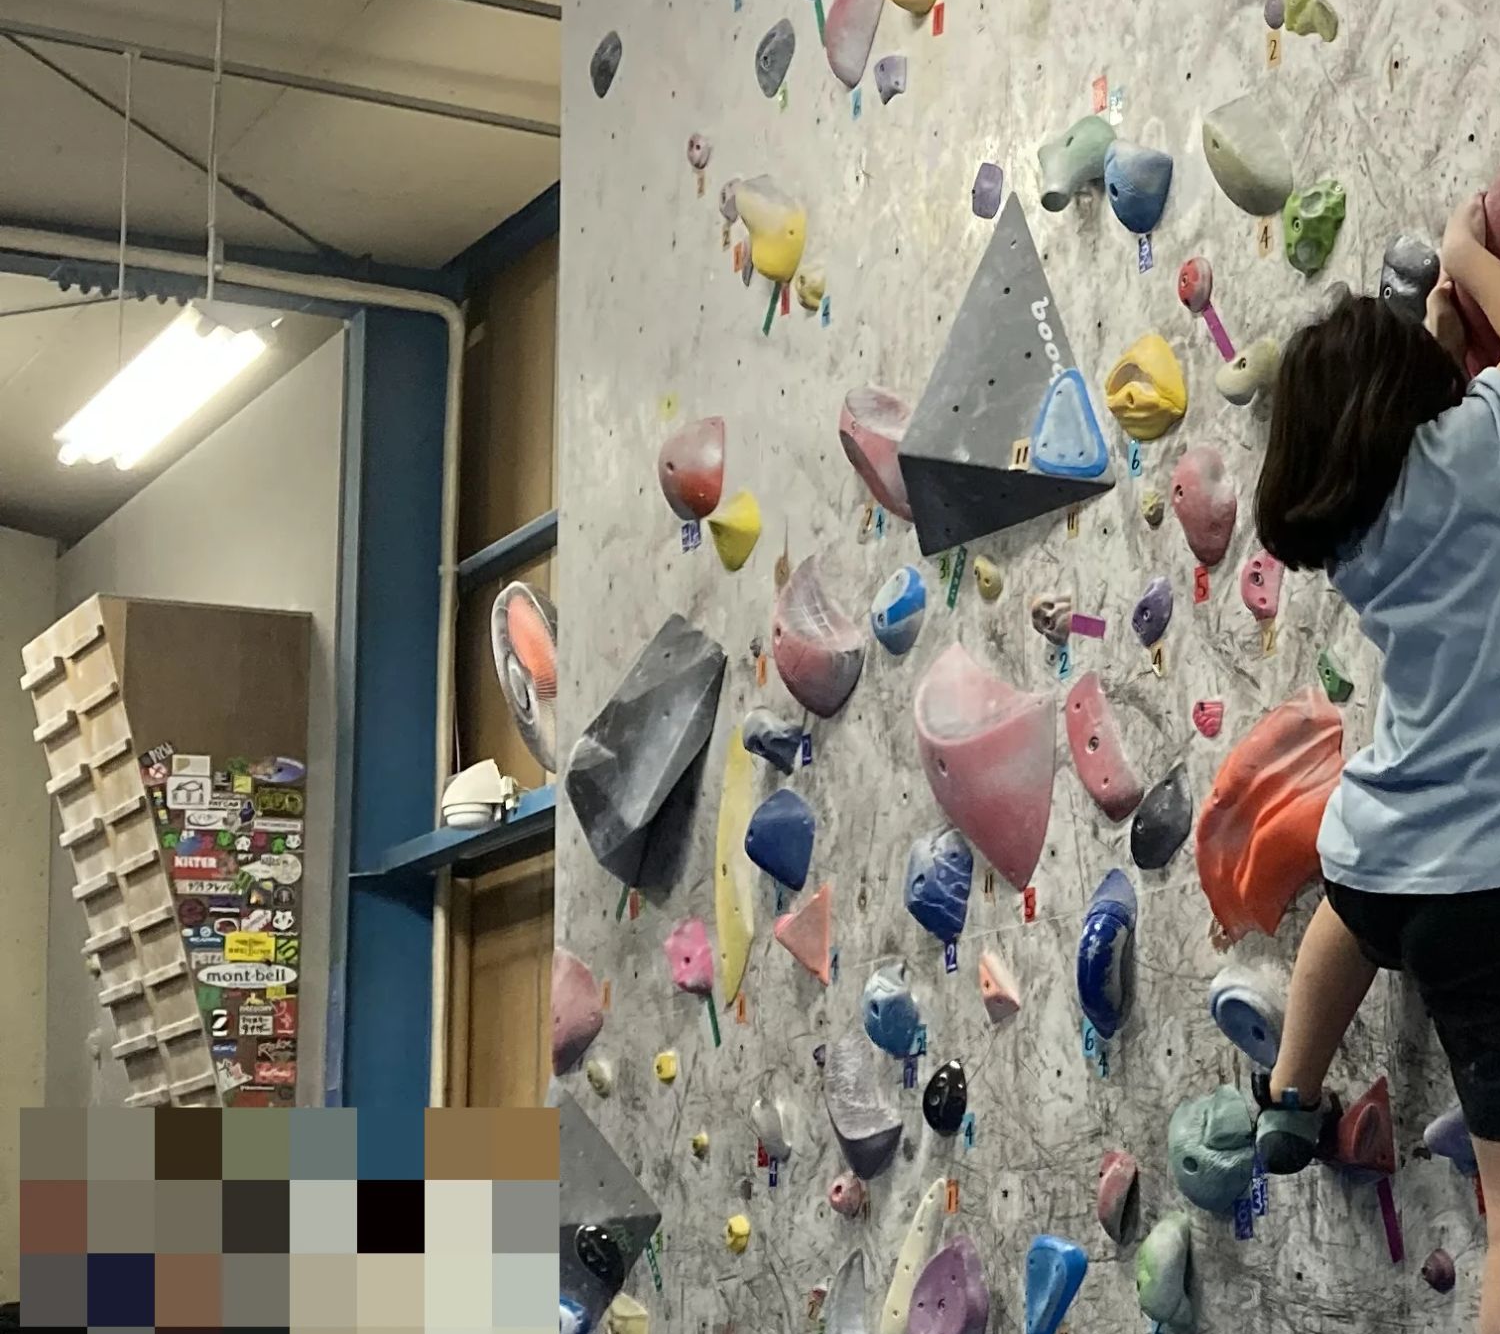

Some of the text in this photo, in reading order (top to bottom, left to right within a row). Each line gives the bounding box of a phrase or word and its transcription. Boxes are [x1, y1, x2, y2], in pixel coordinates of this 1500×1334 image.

[1269, 39, 1277, 61] 2
[1260, 225, 1272, 249] 4
[1016, 445, 1029, 465] 11
[1131, 449, 1139, 470] 6
[1067, 512, 1075, 531] 11
[1196, 573, 1207, 599] 5
[1266, 630, 1274, 651] 2
[1059, 651, 1068, 674] 2
[985, 874, 993, 893] 11
[1025, 894, 1033, 919] 5
[1085, 1027, 1094, 1051] 6
[1098, 1051, 1107, 1077] 4
[965, 1121, 973, 1145] 4
